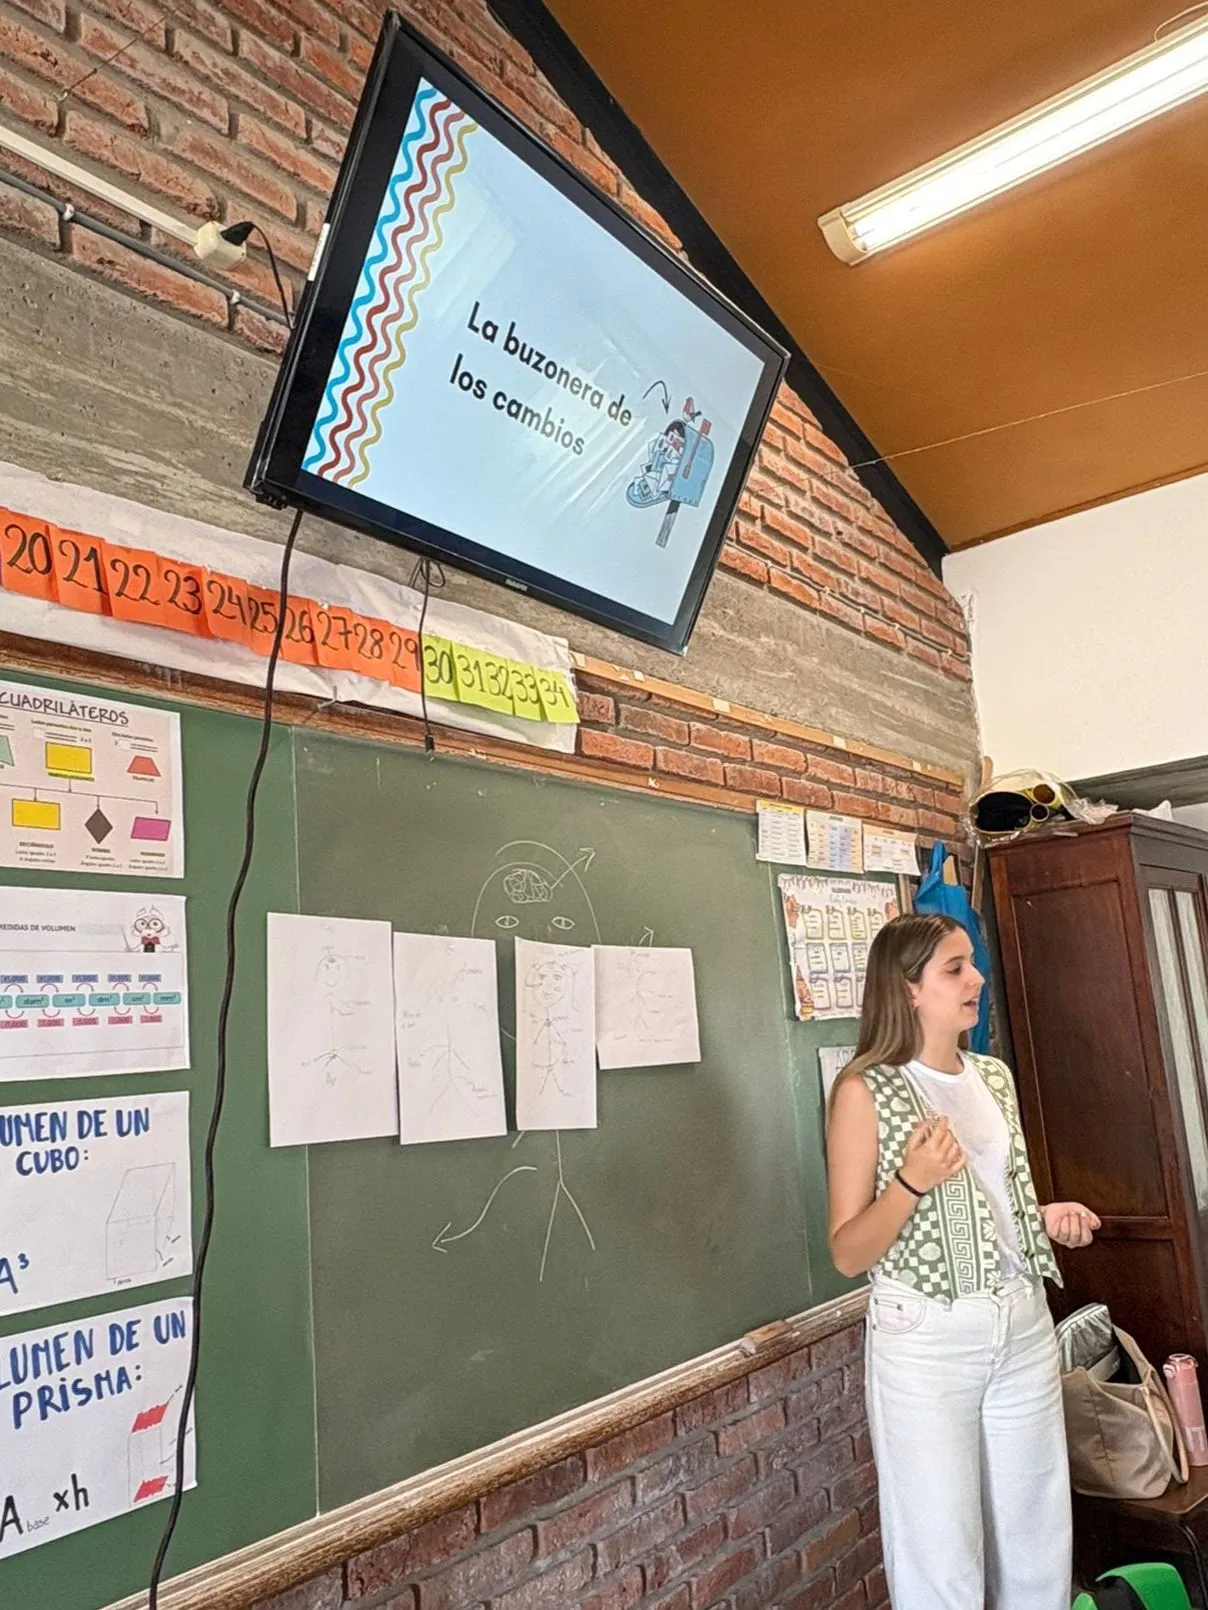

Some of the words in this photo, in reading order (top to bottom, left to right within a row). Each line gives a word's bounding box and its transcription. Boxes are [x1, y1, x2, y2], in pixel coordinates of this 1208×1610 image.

[468, 301, 499, 343] La
[503, 321, 604, 409] buzonera
[608, 394, 632, 426] de
[450, 353, 487, 400] los
[493, 391, 585, 455] cambios
[4, 524, 52, 575] 20
[58, 539, 109, 594] 21
[111, 558, 161, 606] 22
[164, 569, 202, 615] 23
[207, 580, 247, 626] 24
[249, 597, 279, 634] 25
[284, 602, 314, 644] 26
[317, 611, 353, 650] 27
[354, 622, 383, 660] 28
[389, 634, 420, 672] 29
[424, 645, 454, 684] 30
[457, 654, 485, 692] 31
[487, 661, 513, 700] 32
[512, 669, 541, 706] 33
[540, 677, 570, 709] 34
[30, 924, 39, 932] DE
[41, 924, 76, 932] VOLUMEN
[77, 1109, 108, 1140] DE
[115, 1107, 150, 1138] UN
[16, 1146, 89, 1176] CUBO:
[109, 1319, 142, 1356] DE
[154, 1310, 186, 1345] UN
